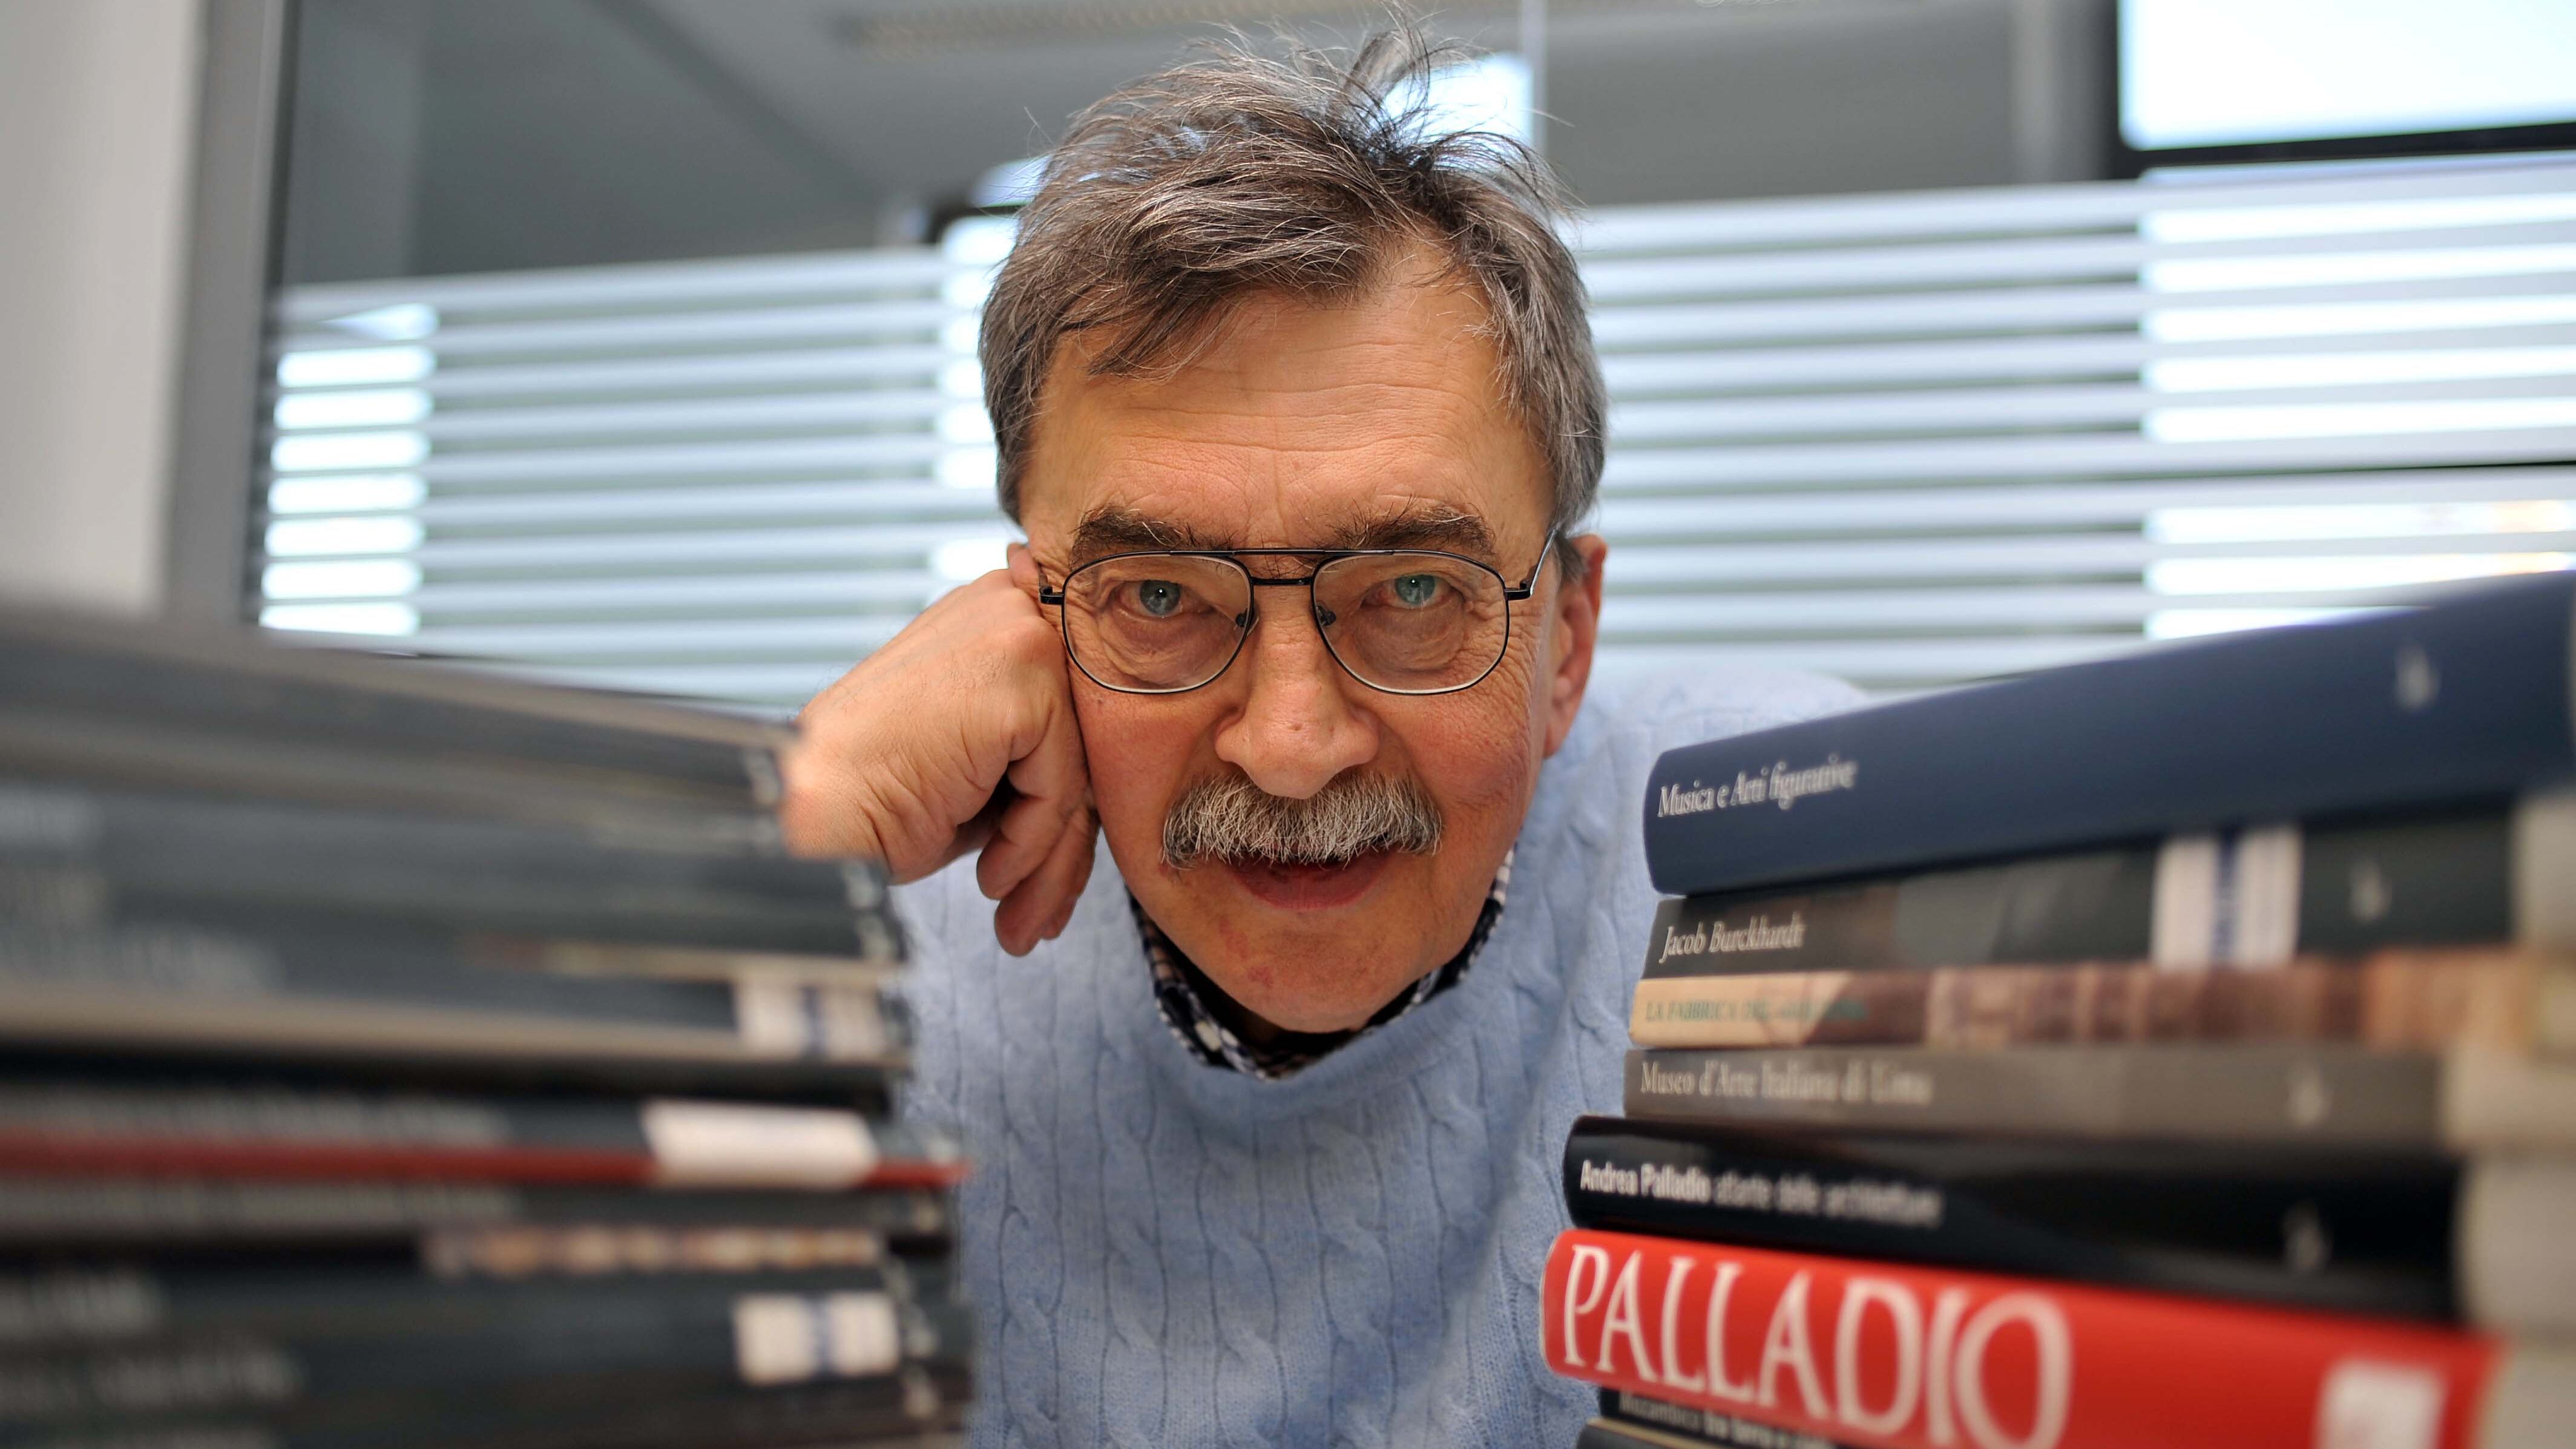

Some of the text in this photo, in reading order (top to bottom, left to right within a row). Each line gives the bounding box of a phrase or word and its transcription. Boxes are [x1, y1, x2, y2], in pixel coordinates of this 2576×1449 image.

[1657, 754, 1859, 818] Musica e Arti figurative
[1658, 911, 1807, 964] Jacob Burckhardt
[1640, 1060, 1697, 1094] Museo
[1698, 1059, 1756, 1098] d'Arte
[1761, 1059, 1839, 1102] Italiana
[1579, 1159, 1638, 1197] Andrea
[1640, 1163, 1712, 1204] Palladio
[1563, 1244, 2072, 1449] PALLADIO
